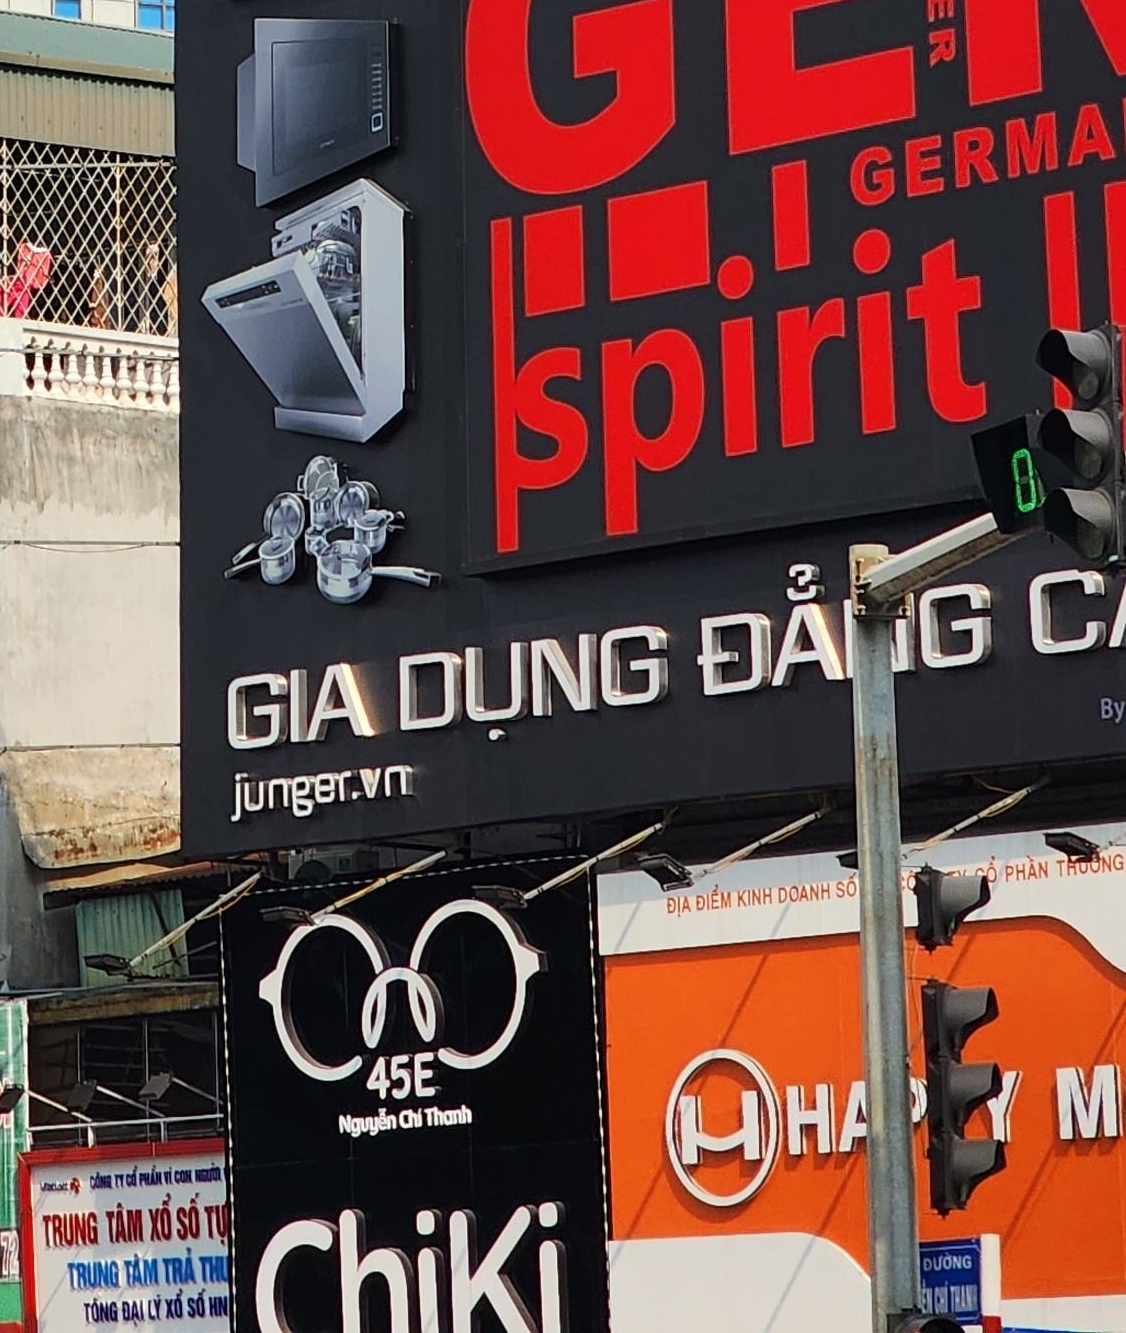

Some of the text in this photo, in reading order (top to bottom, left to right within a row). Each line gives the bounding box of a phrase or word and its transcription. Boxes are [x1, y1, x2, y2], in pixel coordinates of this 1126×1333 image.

[1012, 449, 1036, 512] 0
[227, 663, 379, 750] GIA
[399, 625, 668, 742] DỤNG
[231, 765, 414, 822] junger.vn
[667, 895, 691, 916] ĐỊA
[696, 884, 732, 911] ĐIỂM
[737, 887, 773, 907] KINH
[778, 884, 831, 904] DOANH
[836, 873, 857, 898] SỐ
[1004, 852, 1049, 882] PHẦN
[366, 1052, 442, 1100] 45E
[339, 1105, 472, 1137] Nguyễn Chí Thanh
[90, 1171, 113, 1189] CÔNG
[114, 1173, 124, 1188] TY
[126, 1165, 138, 1187] CỔ
[164, 1168, 172, 1184] VÌ
[174, 1169, 192, 1184] CON
[43, 1192, 201, 1248] TRUNG TÂM XỔ SỐ
[67, 1247, 196, 1290] TRUNG TÂM TRẢ
[256, 1201, 566, 1333] ChiKi
[923, 1253, 972, 1271] ĐƯỜNG
[122, 1299, 144, 1328] ĐẠI
[164, 1288, 183, 1319] XỔ
[187, 1288, 206, 1318] SỐ
